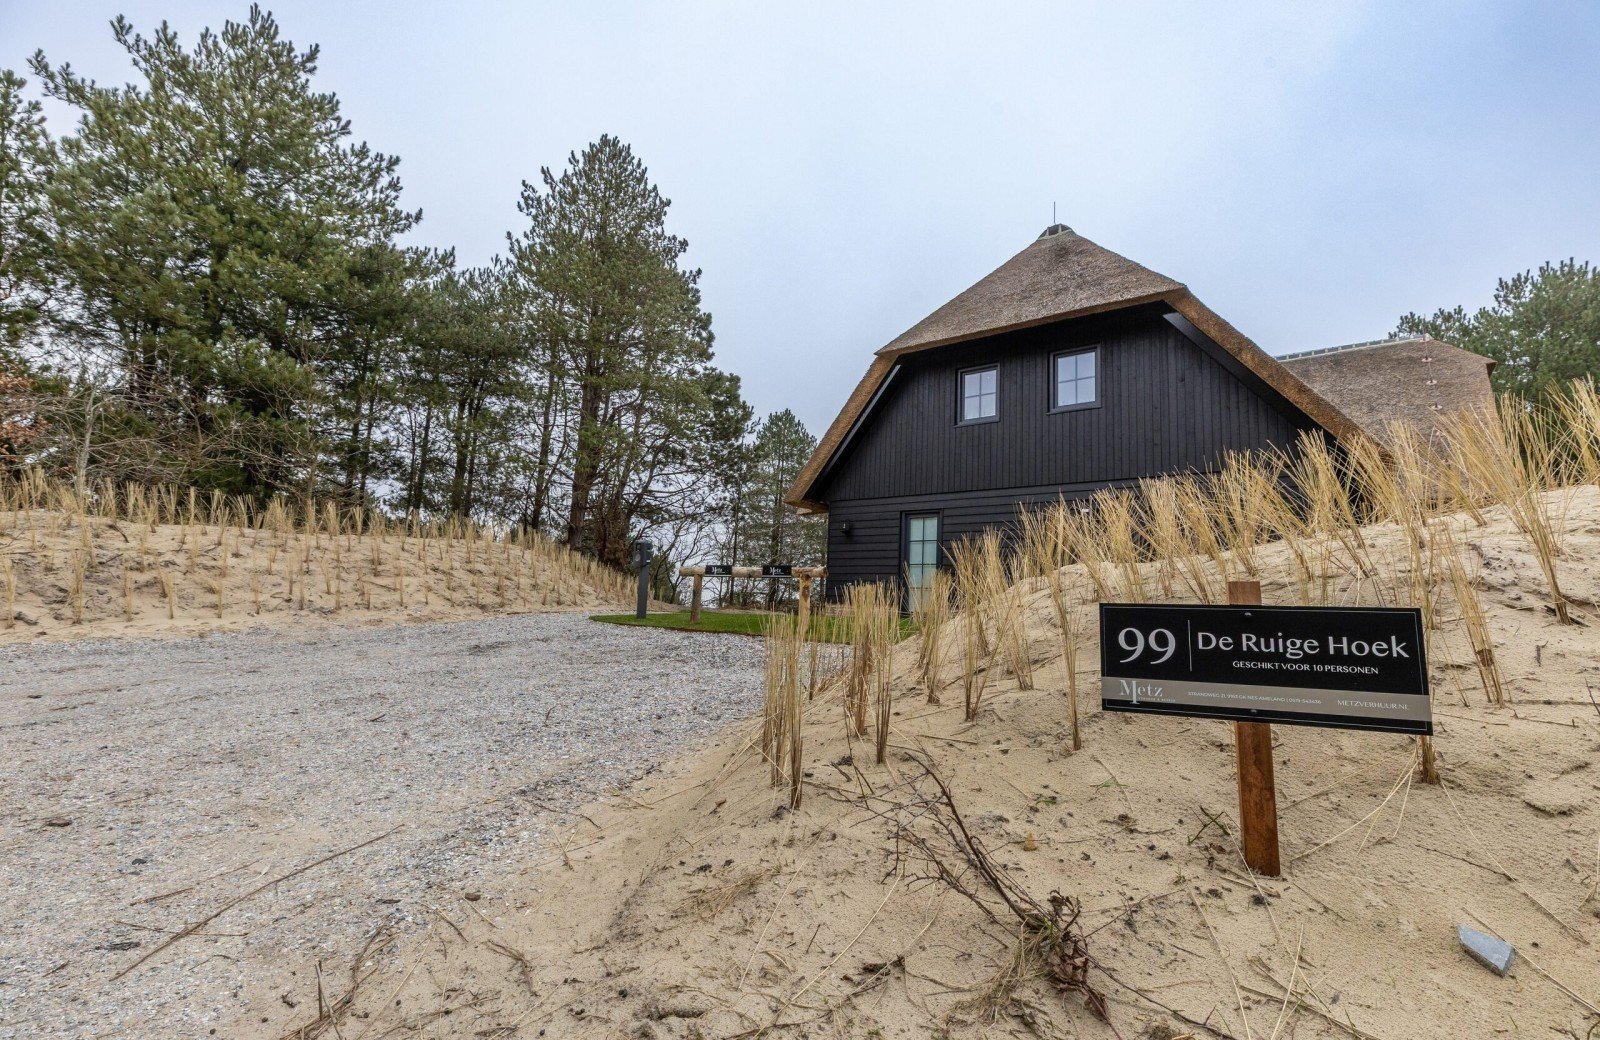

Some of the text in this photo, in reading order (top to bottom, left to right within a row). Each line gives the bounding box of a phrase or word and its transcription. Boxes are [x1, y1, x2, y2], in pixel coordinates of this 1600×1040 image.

[1118, 627, 1176, 664] 99
[1197, 632, 1410, 659] De Ruige Hoek
[1232, 660, 1379, 674] GESCHIKT VOOR 10 PERSONEN
[1120, 680, 1163, 704] Metz
[1337, 700, 1409, 710] METZVERHUUR.NL
